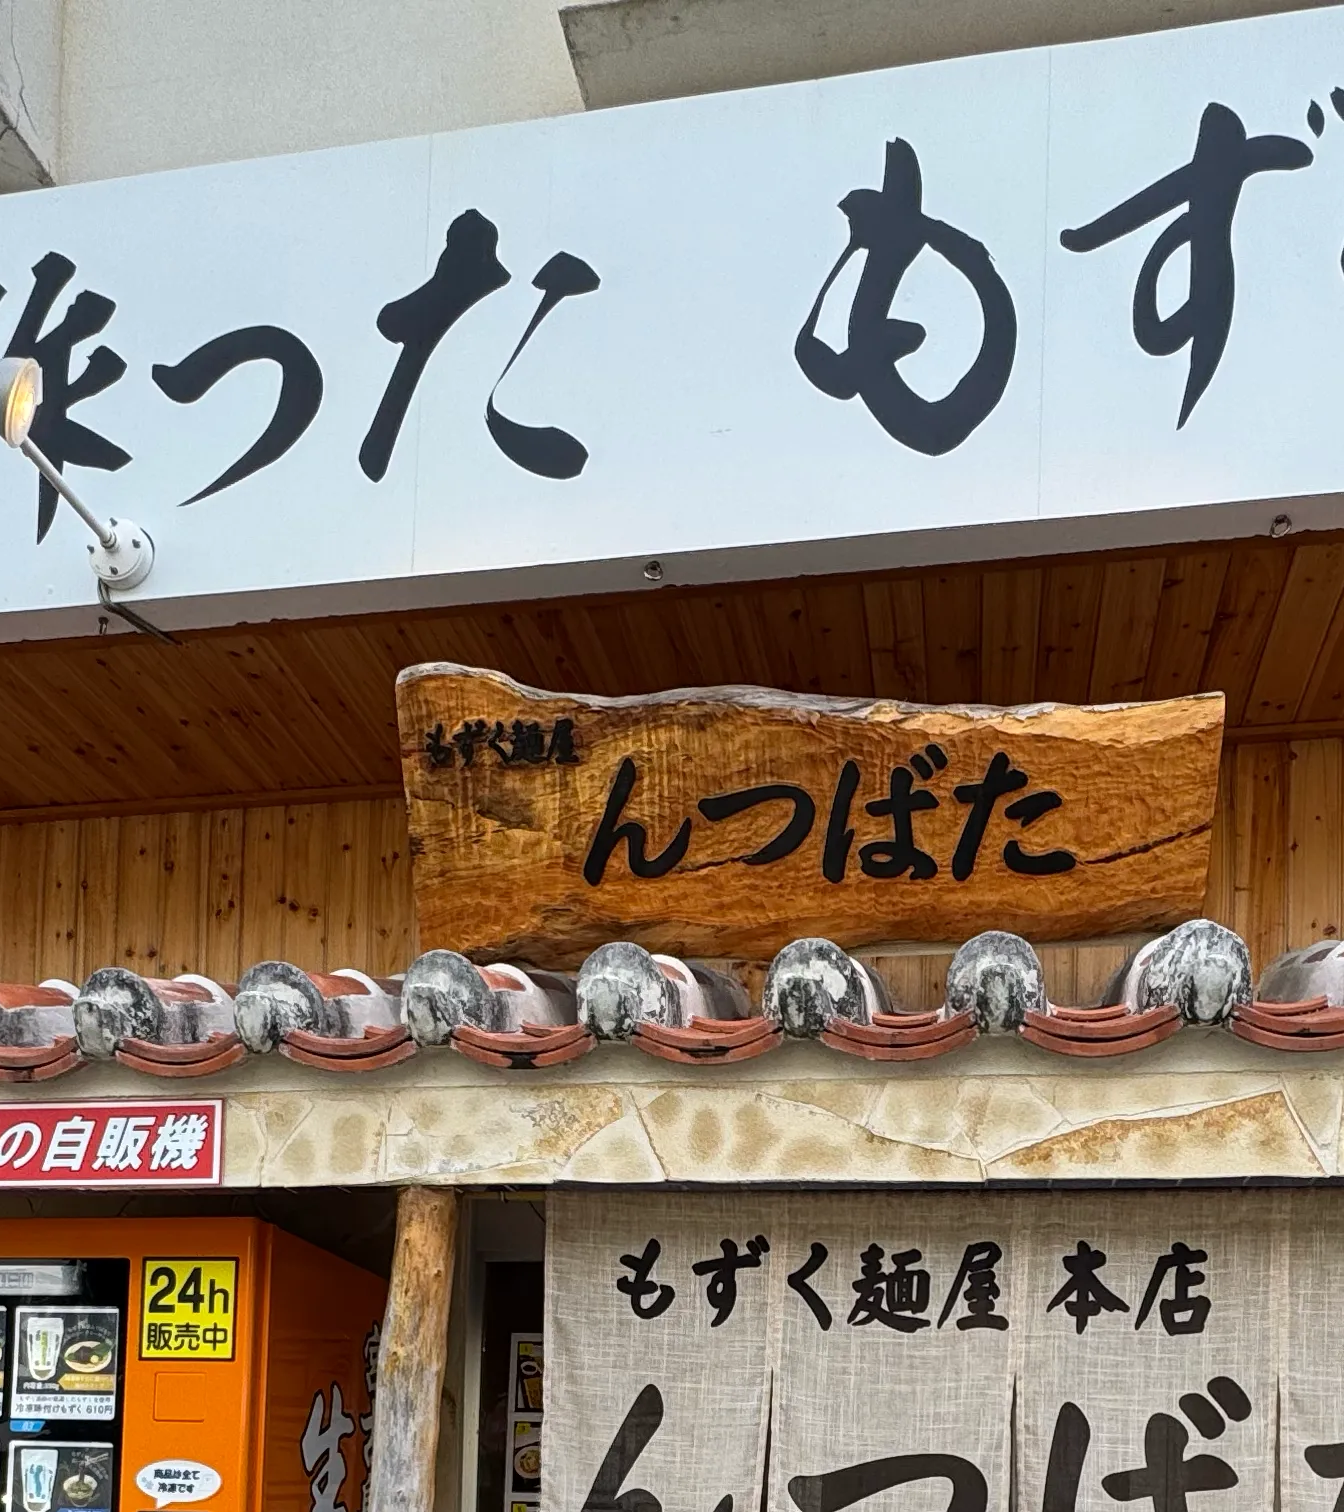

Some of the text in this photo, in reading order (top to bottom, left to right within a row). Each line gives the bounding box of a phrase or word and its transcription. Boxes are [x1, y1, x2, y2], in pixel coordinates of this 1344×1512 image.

[584, 744, 1076, 885] んつばた
[147, 1266, 230, 1315] 24h
[616, 1234, 1211, 1338] もずく麺屋 本店
[145, 1322, 229, 1353] 販売中
